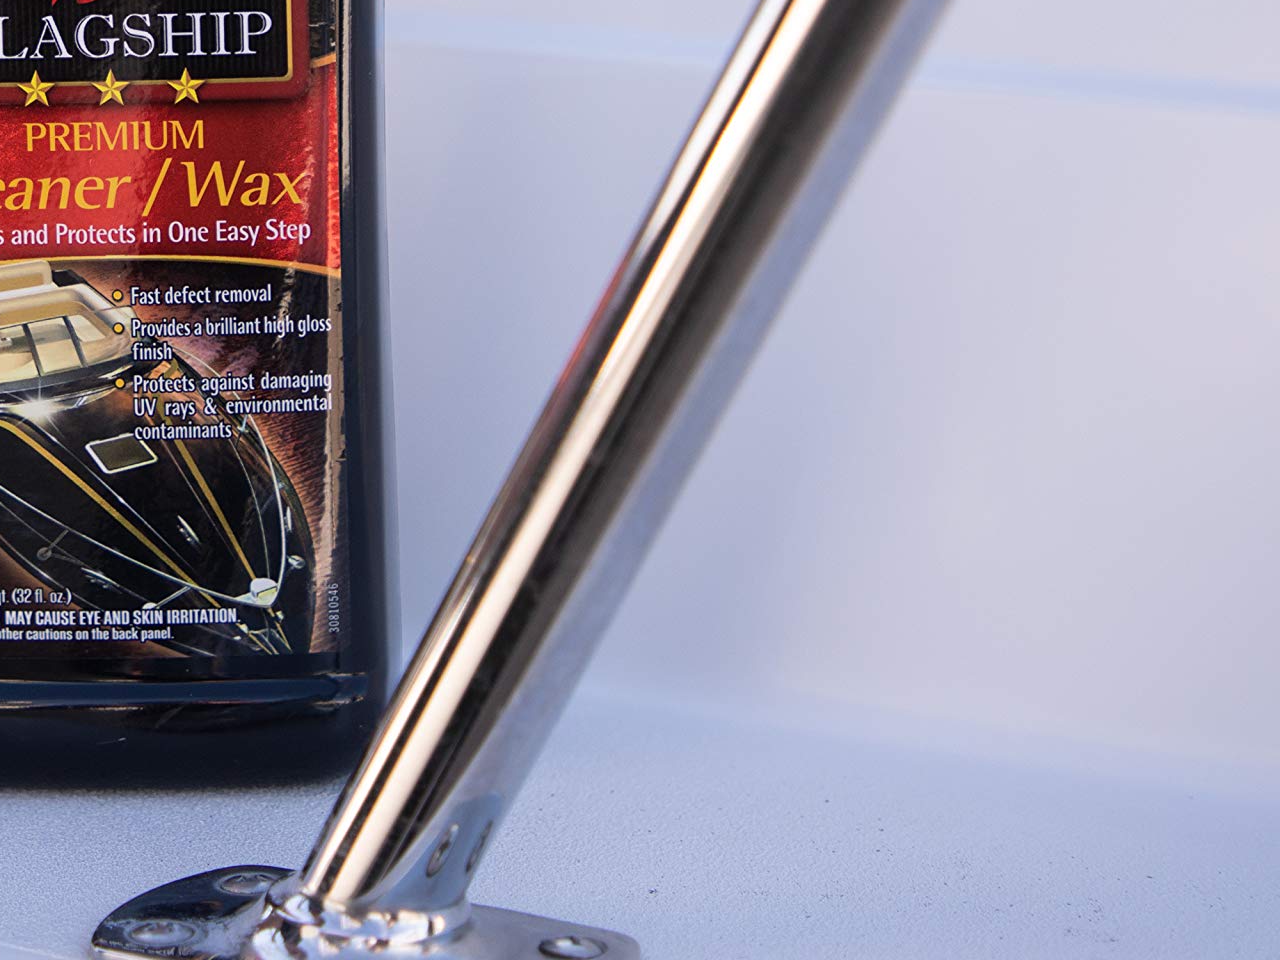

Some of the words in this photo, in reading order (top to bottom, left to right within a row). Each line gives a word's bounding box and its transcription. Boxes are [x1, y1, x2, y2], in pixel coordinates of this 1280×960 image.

[23, 120, 204, 152] PREMIUM
[181, 160, 304, 208] Wax
[11, 225, 48, 245] and
[56, 223, 136, 244] Protects
[143, 222, 161, 242] in
[168, 222, 208, 242] One
[216, 220, 258, 245] Easy
[266, 219, 311, 245] Step
[130, 287, 161, 305] Fast
[165, 286, 211, 304] defect
[215, 284, 271, 302] removal
[132, 318, 190, 337] Provides
[194, 321, 202, 335] a
[206, 317, 261, 335] brilliant
[264, 316, 294, 338] high
[298, 315, 332, 337] gloss
[133, 343, 172, 360] finish
[133, 375, 195, 393] Protects
[201, 373, 255, 395] against
[260, 370, 332, 392] damaging
[134, 398, 156, 416] UV
[165, 401, 195, 419] rays
[204, 398, 217, 414] &
[226, 392, 332, 414] environmental
[135, 422, 232, 439] contaminants
[12, 588, 32, 605] (32
[35, 589, 46, 603] fl.
[50, 588, 72, 605] oz.)
[328, 583, 340, 633] 30810546
[5, 611, 32, 625] MAY
[35, 611, 76, 625] CAUSE
[79, 611, 101, 624] EYE
[103, 611, 130, 624] AND
[133, 610, 163, 624] SKIN
[167, 608, 240, 624] IRRITATION.
[26, 628, 72, 640] cautions
[75, 630, 89, 640] on
[91, 628, 108, 639] the
[112, 627, 138, 639] back
[141, 627, 174, 642] panel.
